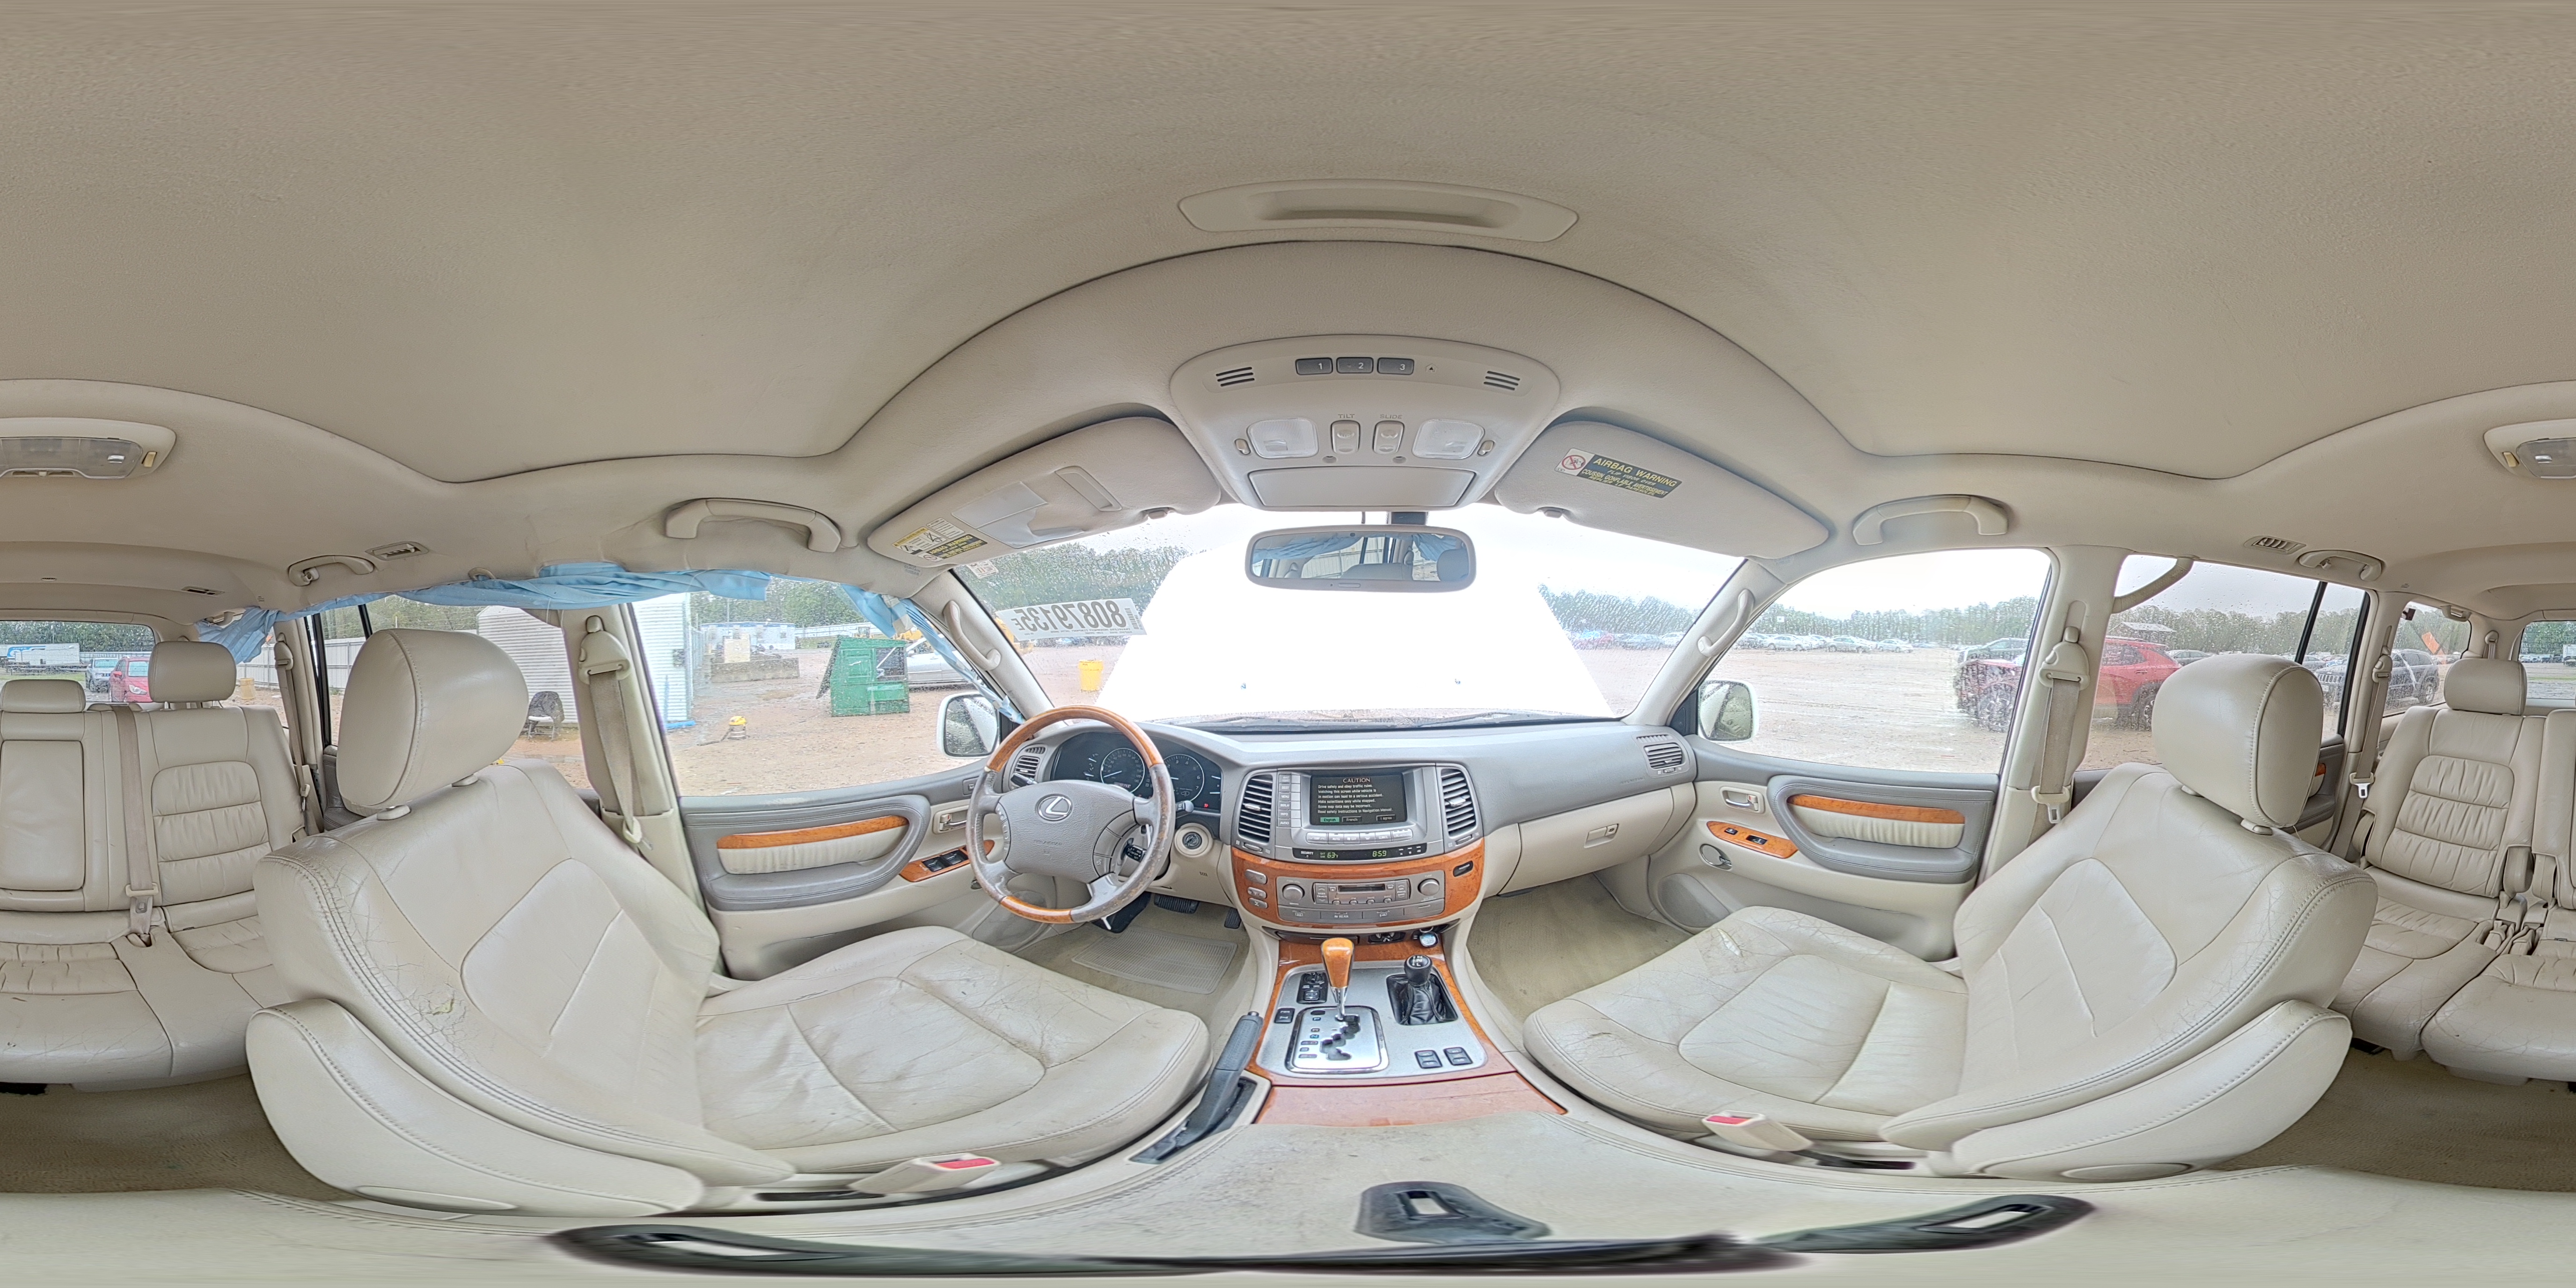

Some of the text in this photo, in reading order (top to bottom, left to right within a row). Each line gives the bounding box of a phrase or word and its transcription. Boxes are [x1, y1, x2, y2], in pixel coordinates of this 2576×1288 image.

[1581, 469, 1669, 495] COUSSIN GONFLABLE AVERTISSEMENT
[1593, 458, 1677, 487] AIRBAG WARNING
[946, 535, 973, 547] WARNING
